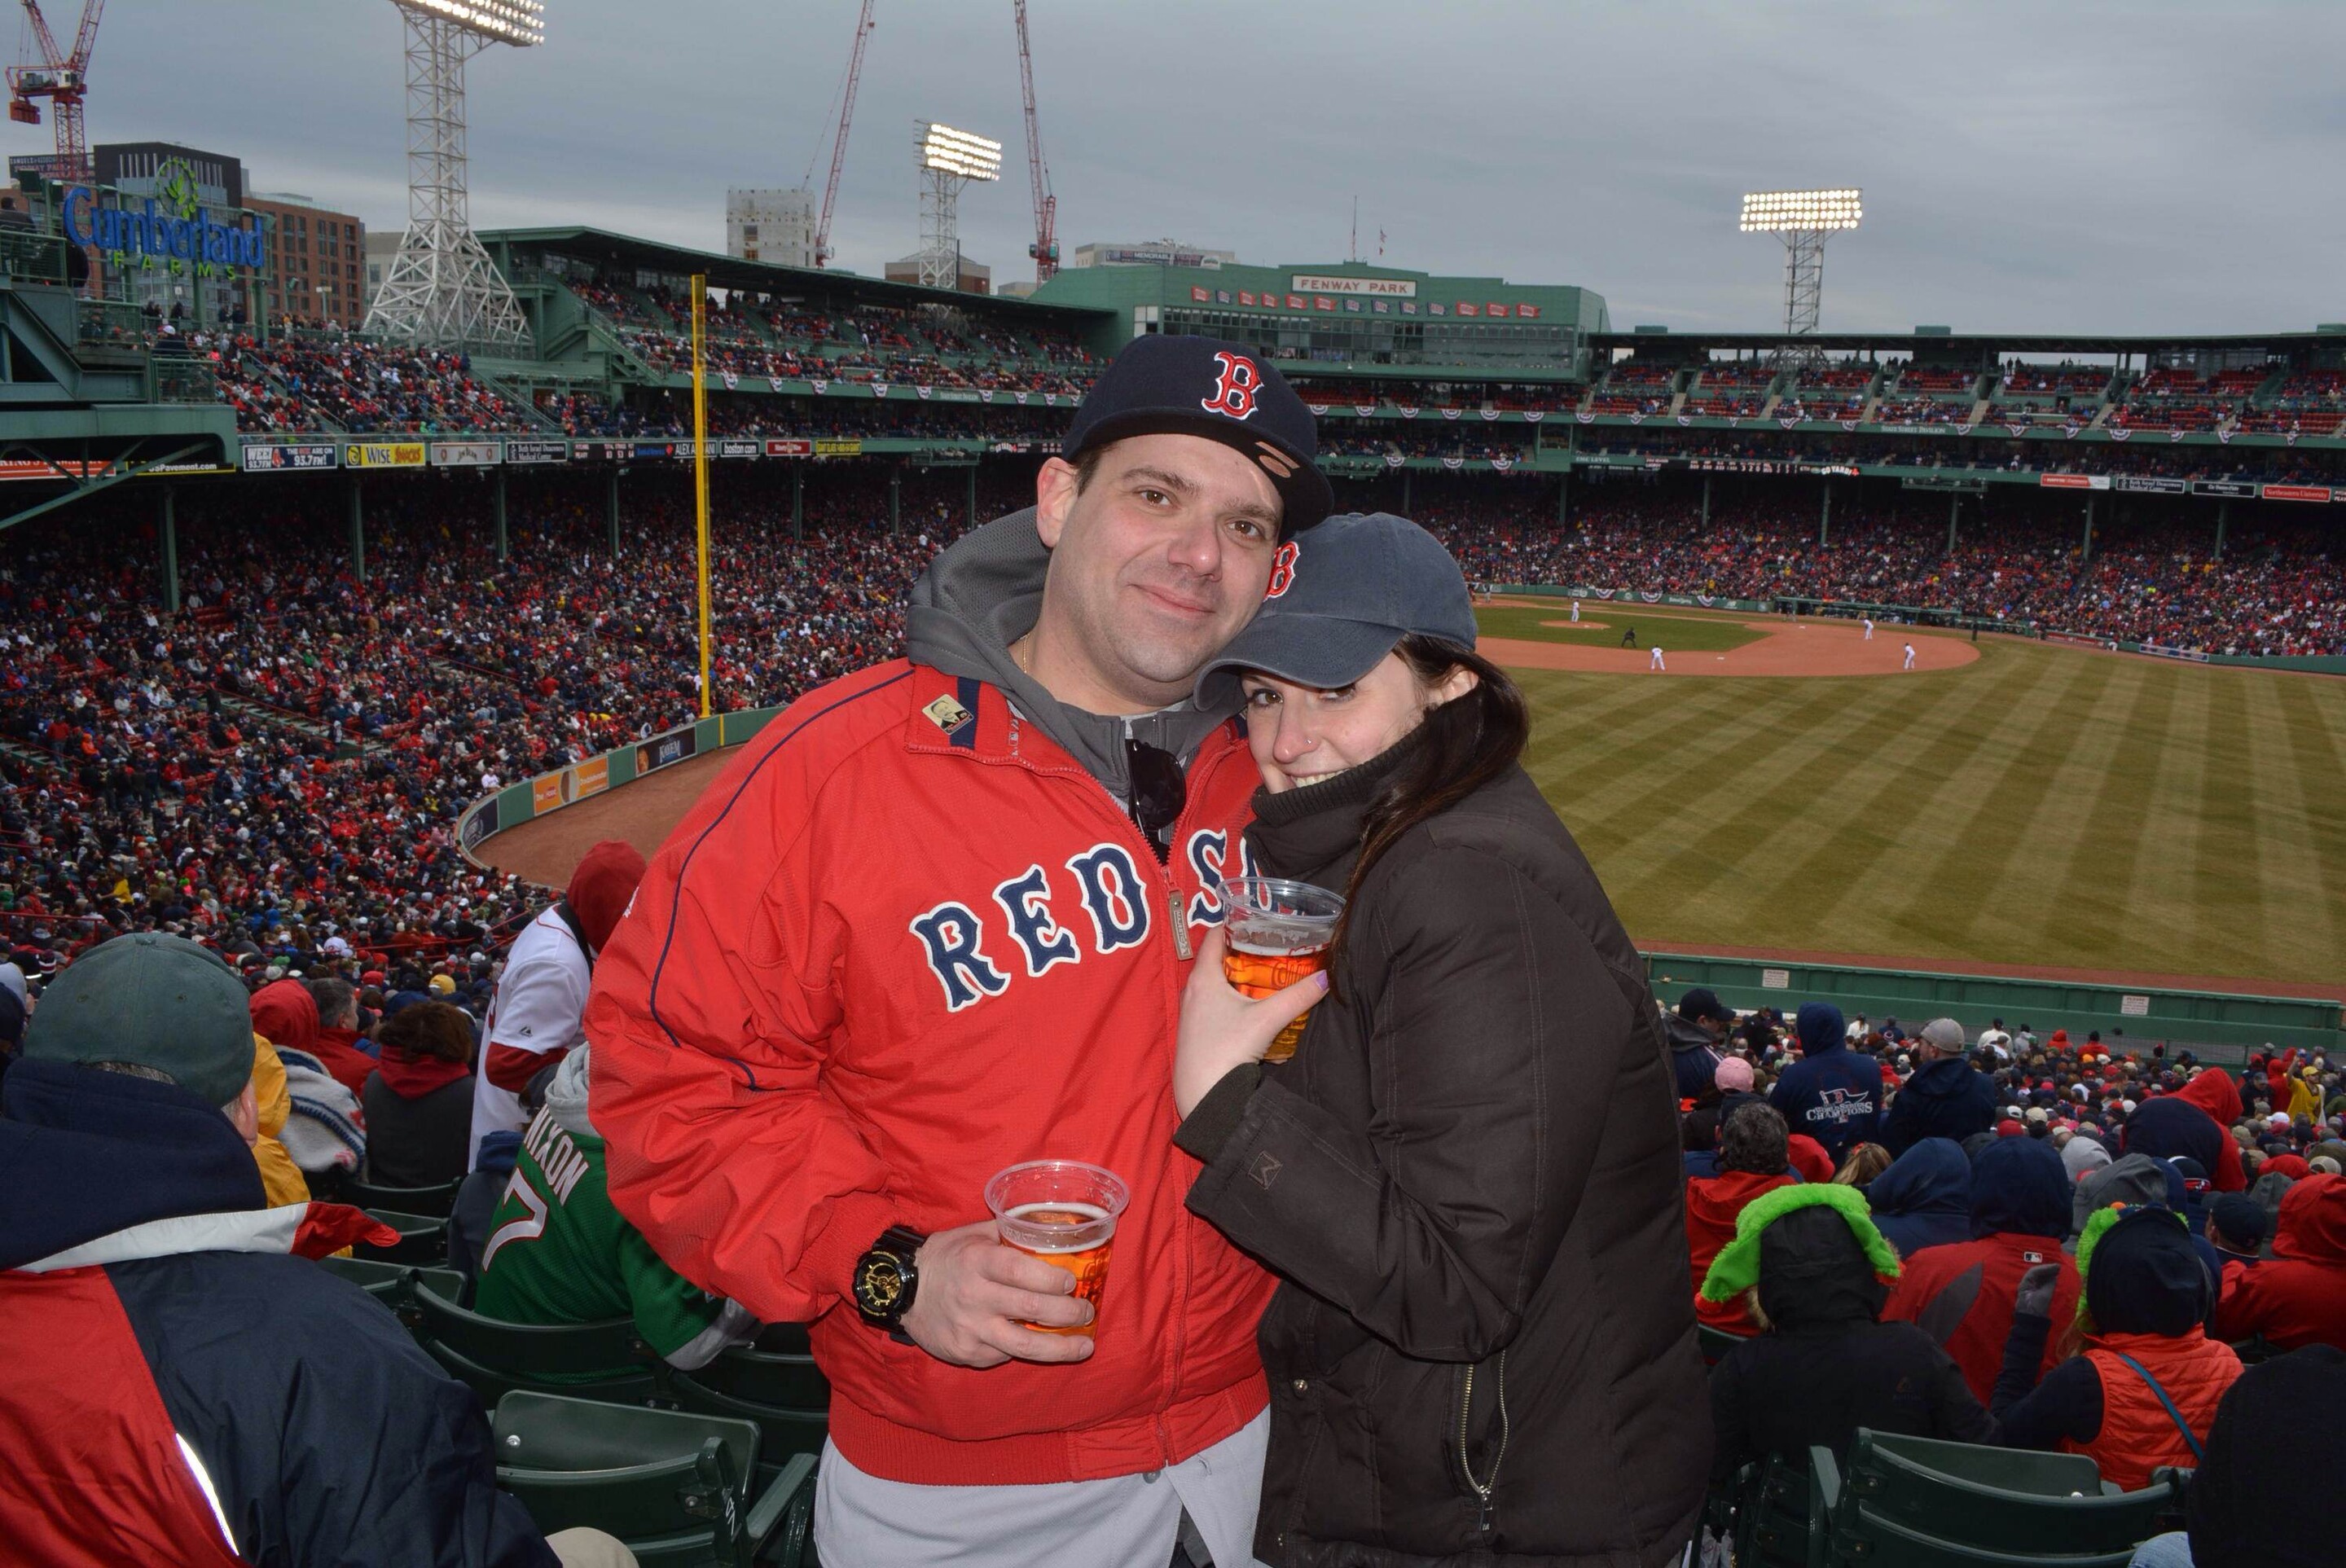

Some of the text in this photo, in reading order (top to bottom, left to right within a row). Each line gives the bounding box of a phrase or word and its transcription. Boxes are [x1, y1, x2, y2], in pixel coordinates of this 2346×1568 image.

[63, 187, 266, 268] Cumberland
[113, 250, 236, 281] FARMS
[1301, 279, 1408, 293] FENWAY PARK
[1202, 351, 1264, 420] B
[675, 443, 690, 455] ALEX
[1821, 467, 1830, 475] GO
[2300, 490, 2327, 499] University
[1263, 541, 1301, 603] B
[909, 828, 1281, 1012] RED SO
[1805, 1101, 1874, 1121] CHAMPIONS
[523, 1103, 589, 1206] NIXON
[482, 1166, 549, 1272] 7
